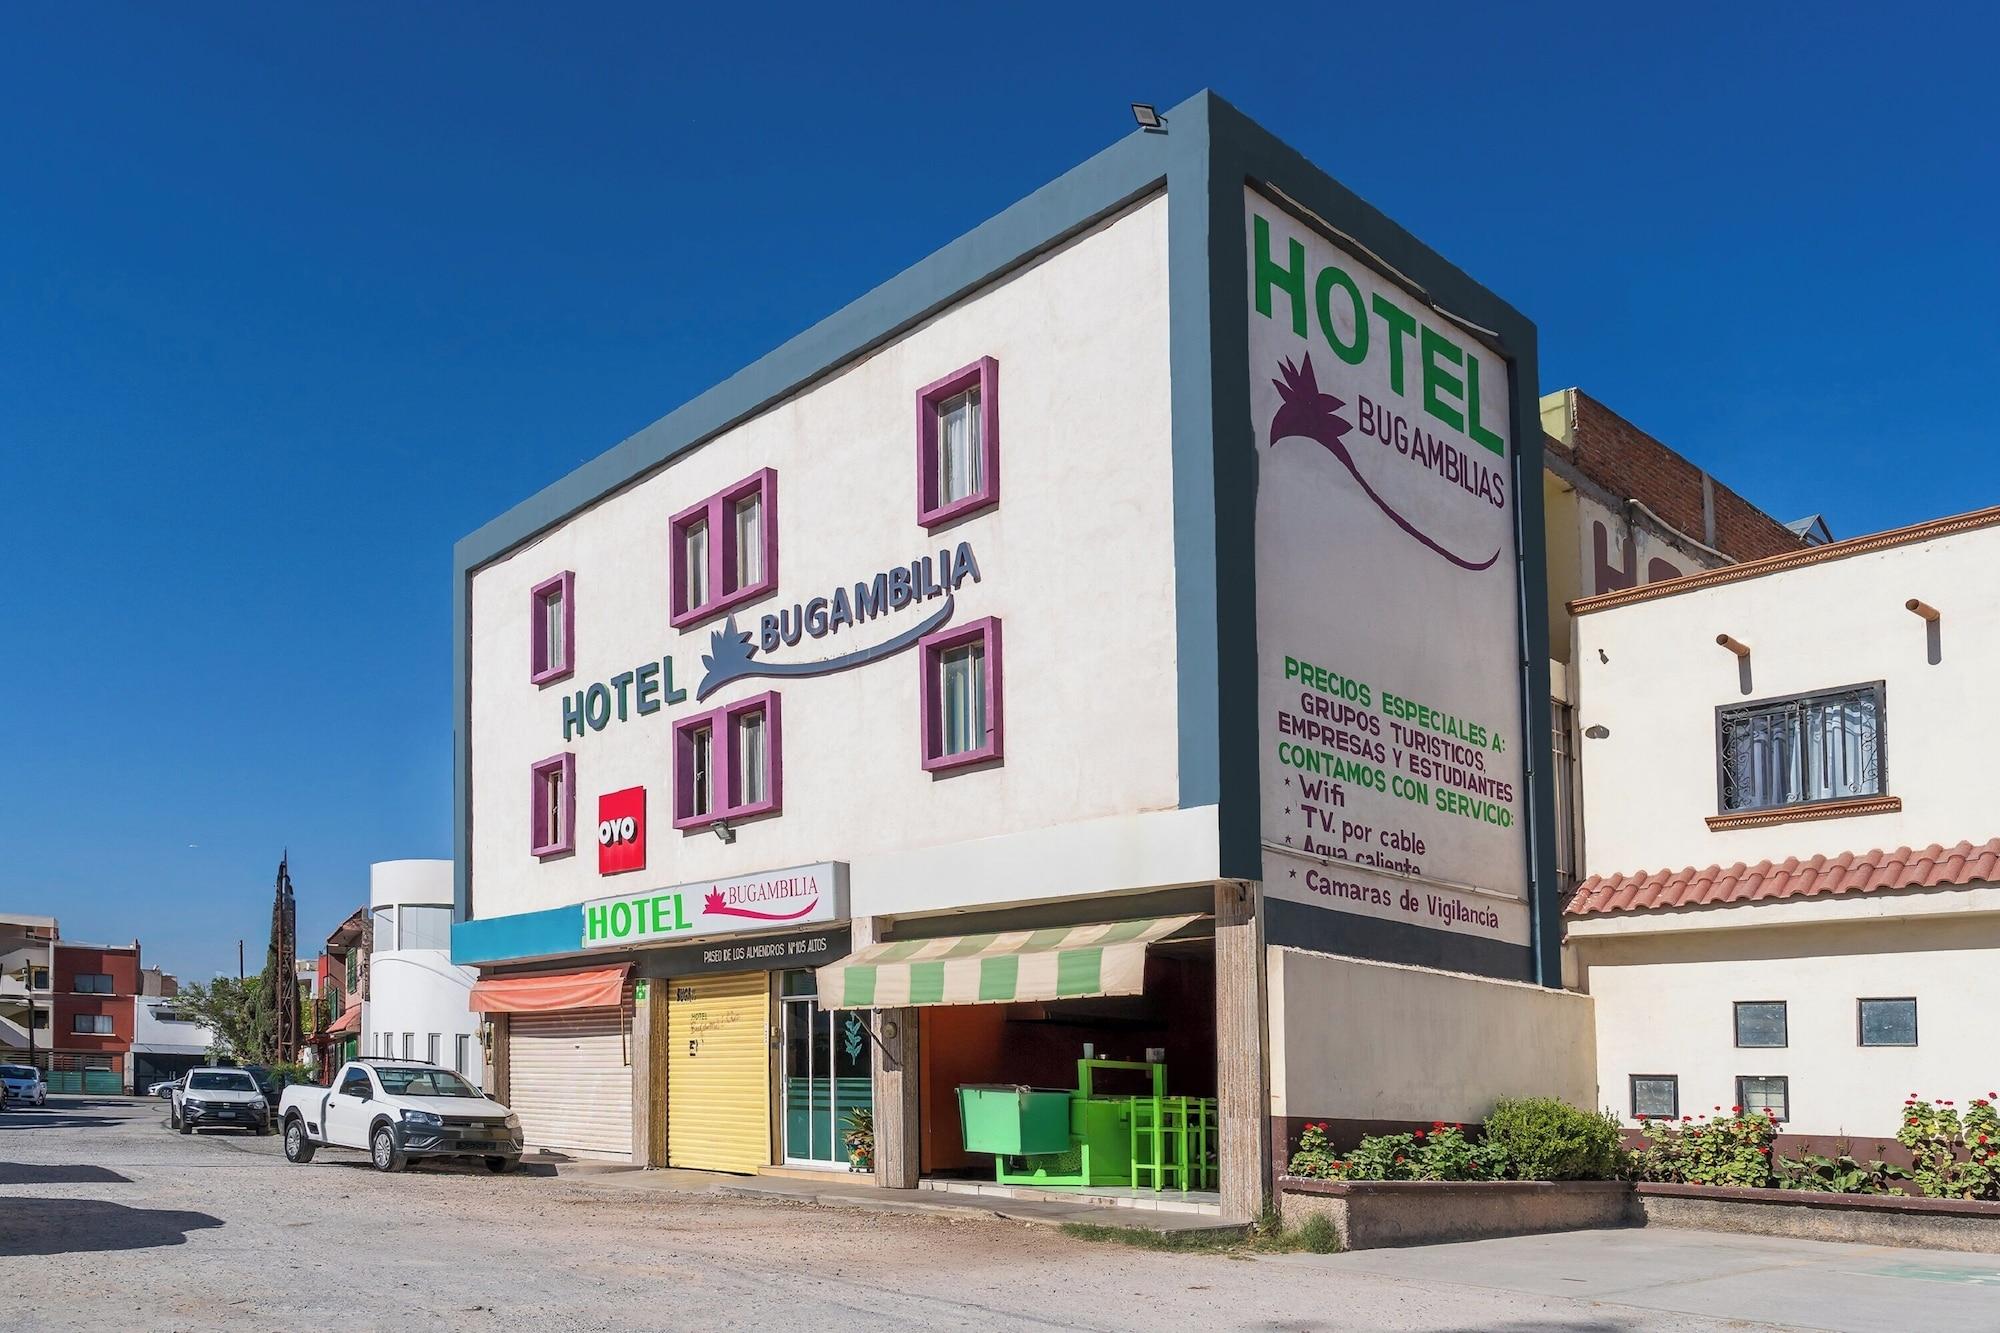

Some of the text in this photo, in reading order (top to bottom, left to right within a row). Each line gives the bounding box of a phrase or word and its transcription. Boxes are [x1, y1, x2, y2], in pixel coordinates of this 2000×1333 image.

[1254, 213, 1504, 458] HOTEL
[1358, 394, 1505, 509] BUGAMBILIAS
[760, 541, 981, 653] BUGAMBILIA
[562, 655, 687, 742] HOTEL
[1285, 656, 1371, 707] PRECIOS
[1382, 691, 1487, 749] ESPECIALES
[1302, 692, 1380, 736] GRUPOS
[1278, 710, 1513, 802] EMPRESAS Y ESTUDIANTES
[1279, 741, 1386, 793] CONTAMOS
[1392, 775, 1429, 805] CON
[1299, 774, 1345, 807] Wifi
[599, 816, 636, 846] OYO
[1301, 804, 1426, 855] TV. por cable
[589, 876, 818, 940] HOTEL BUGAMBILIA
[1306, 869, 1391, 906] Camaras
[1400, 889, 1419, 913] de
[703, 949, 722, 963] PASEO
[723, 947, 731, 961] DE
[732, 947, 745, 961] LOS
[746, 943, 785, 959] ALMENDROS
[807, 937, 827, 953] ALTOS
